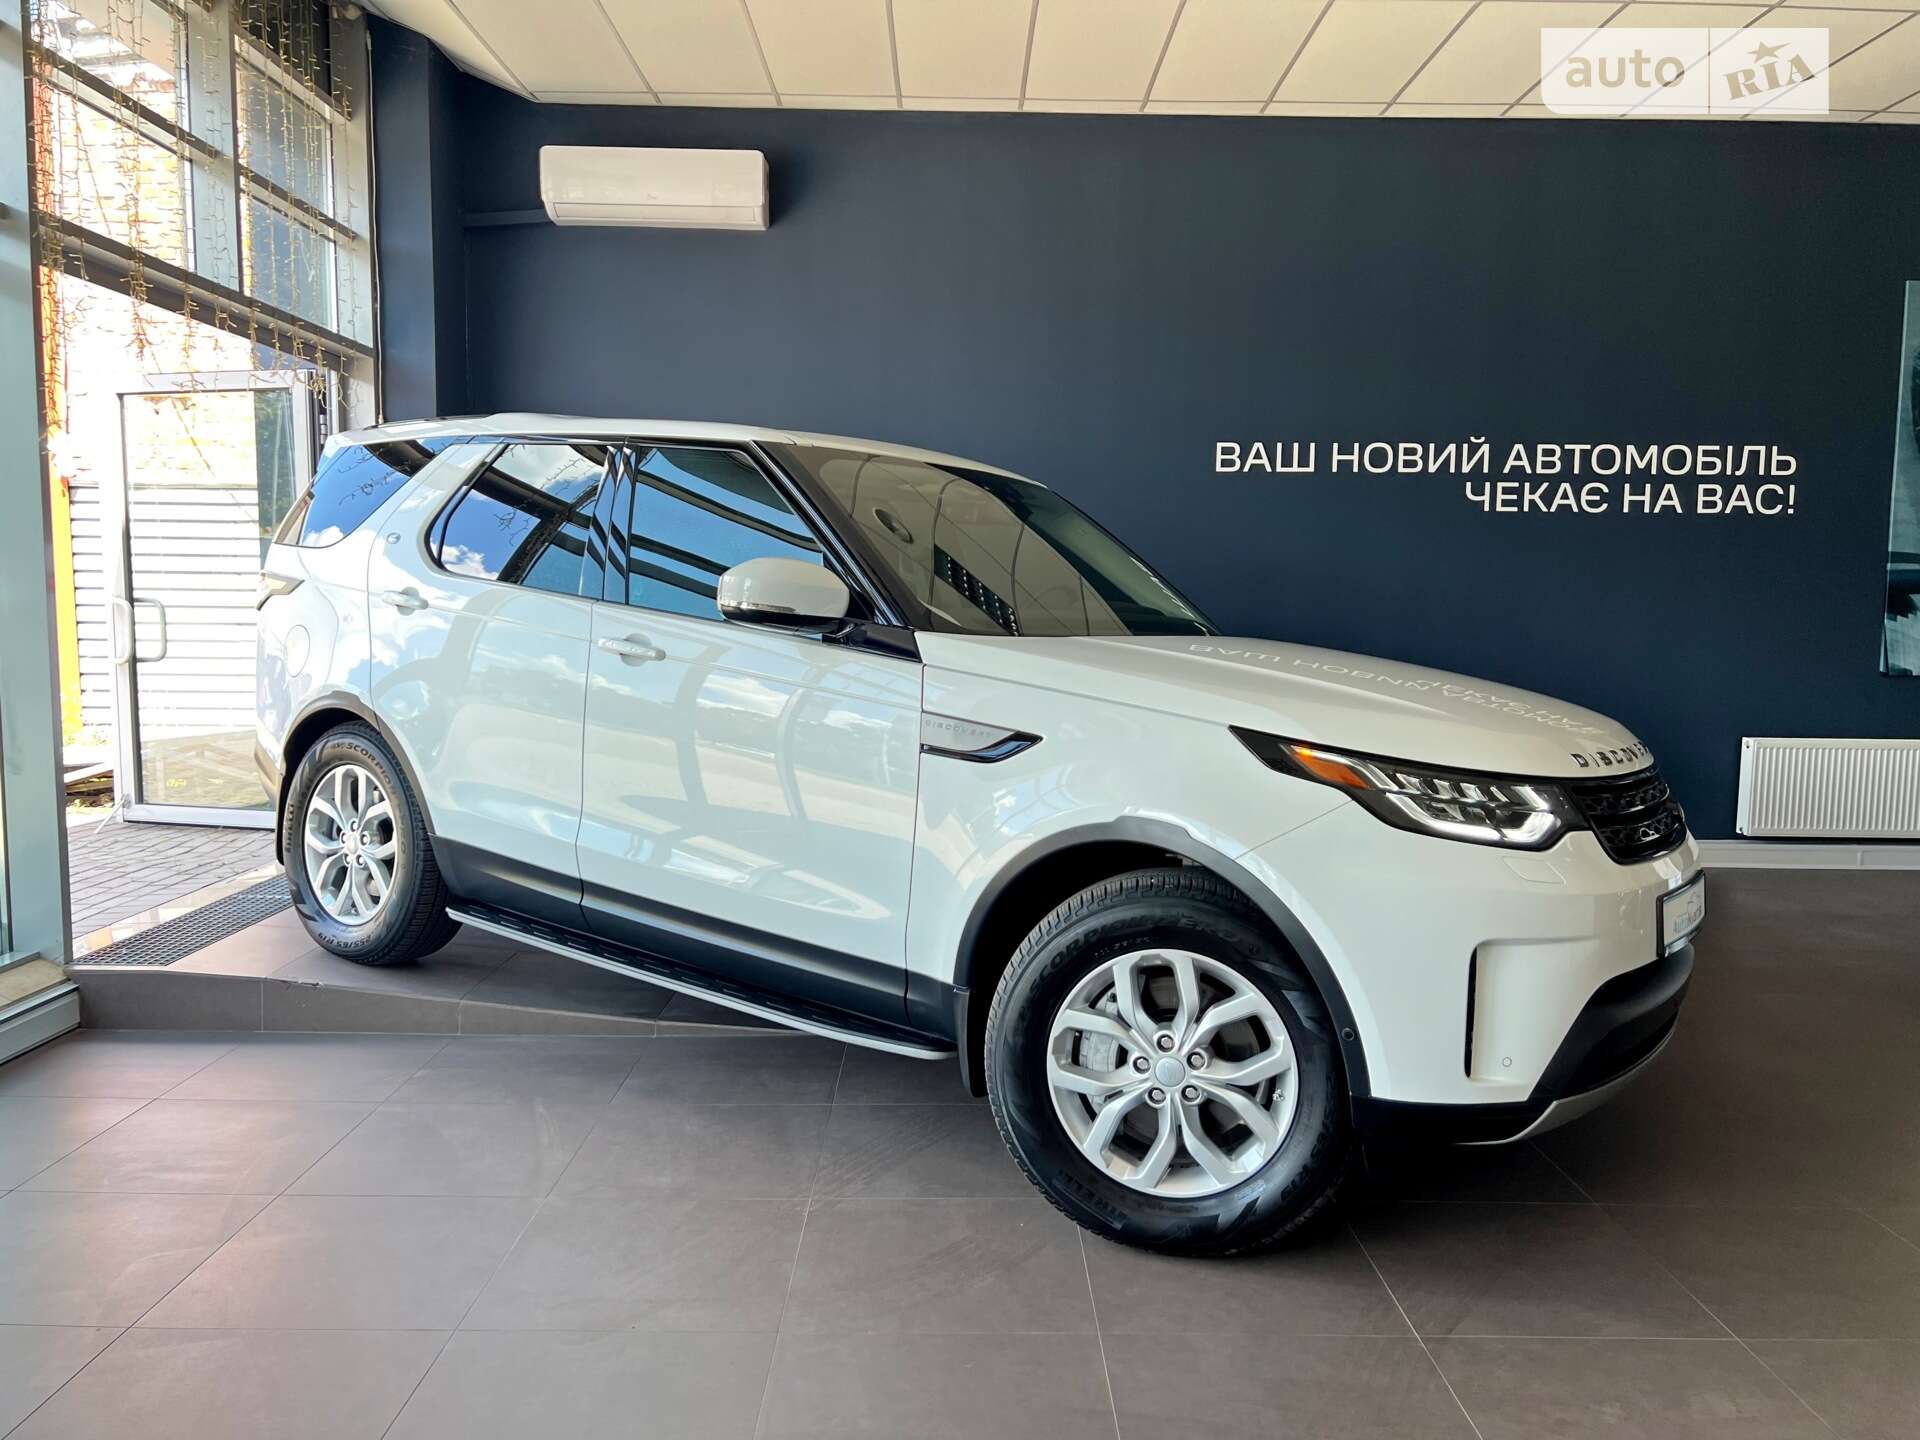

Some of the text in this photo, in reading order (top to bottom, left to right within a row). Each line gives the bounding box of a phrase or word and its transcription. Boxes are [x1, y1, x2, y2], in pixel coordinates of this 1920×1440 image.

[1215, 436, 1797, 476] ВАШ НОВИЙ АВТОМОБІЛЬ
[1465, 481, 1796, 515] ЧЕКАЄ НА ВАС!
[1569, 741, 1649, 768] DISCOVE
